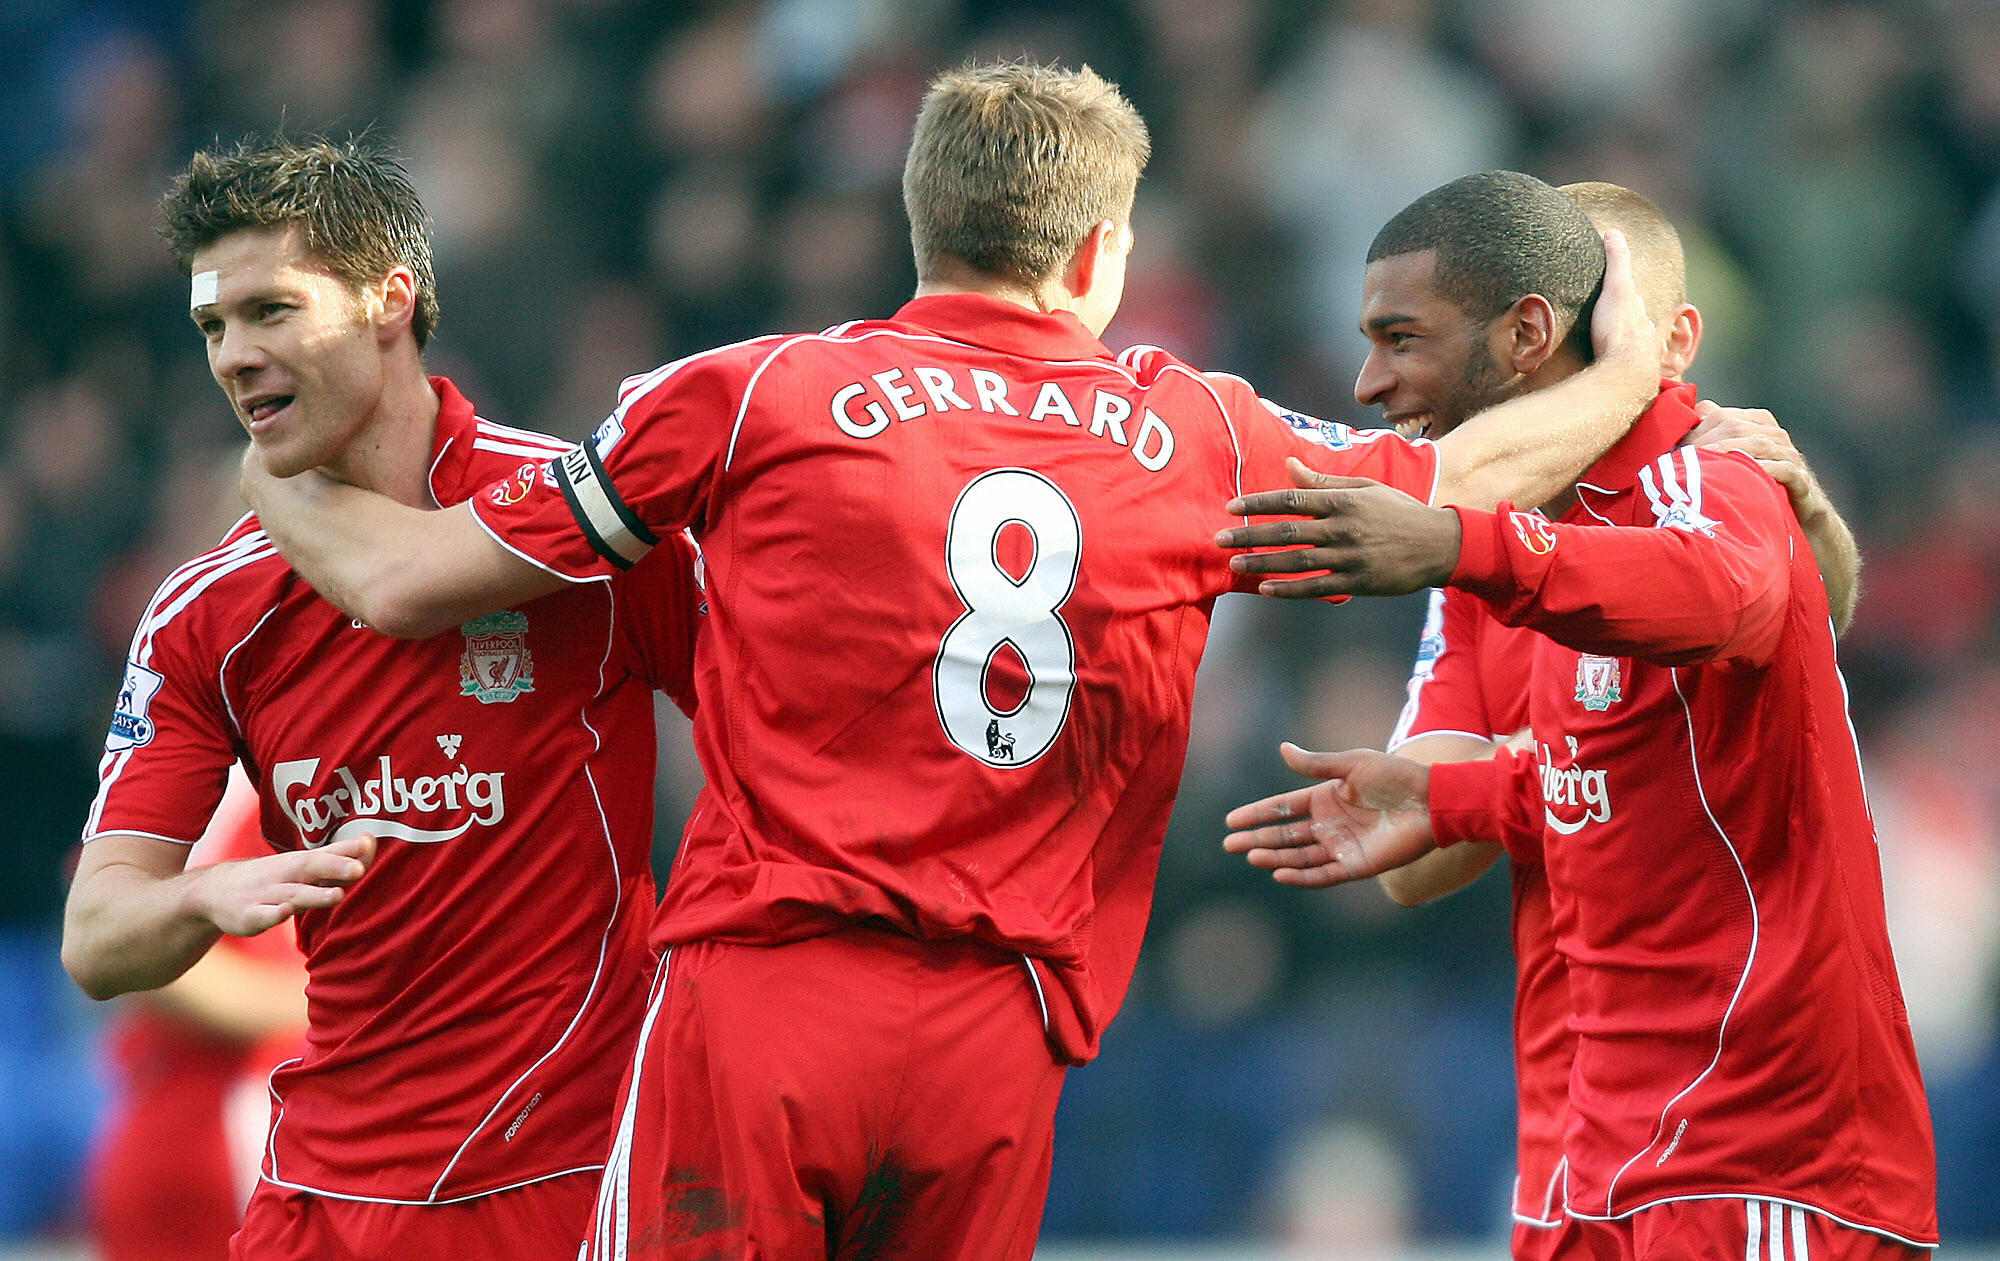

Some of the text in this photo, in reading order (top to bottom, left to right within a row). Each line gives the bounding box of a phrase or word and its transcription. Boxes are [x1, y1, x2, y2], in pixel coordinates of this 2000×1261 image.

[830, 366, 1176, 472] GERRARD
[564, 449, 592, 485] AIN
[471, 639, 519, 650] LIVERPOOL
[932, 466, 1084, 770] 8
[272, 755, 506, 849] Carlsberg
